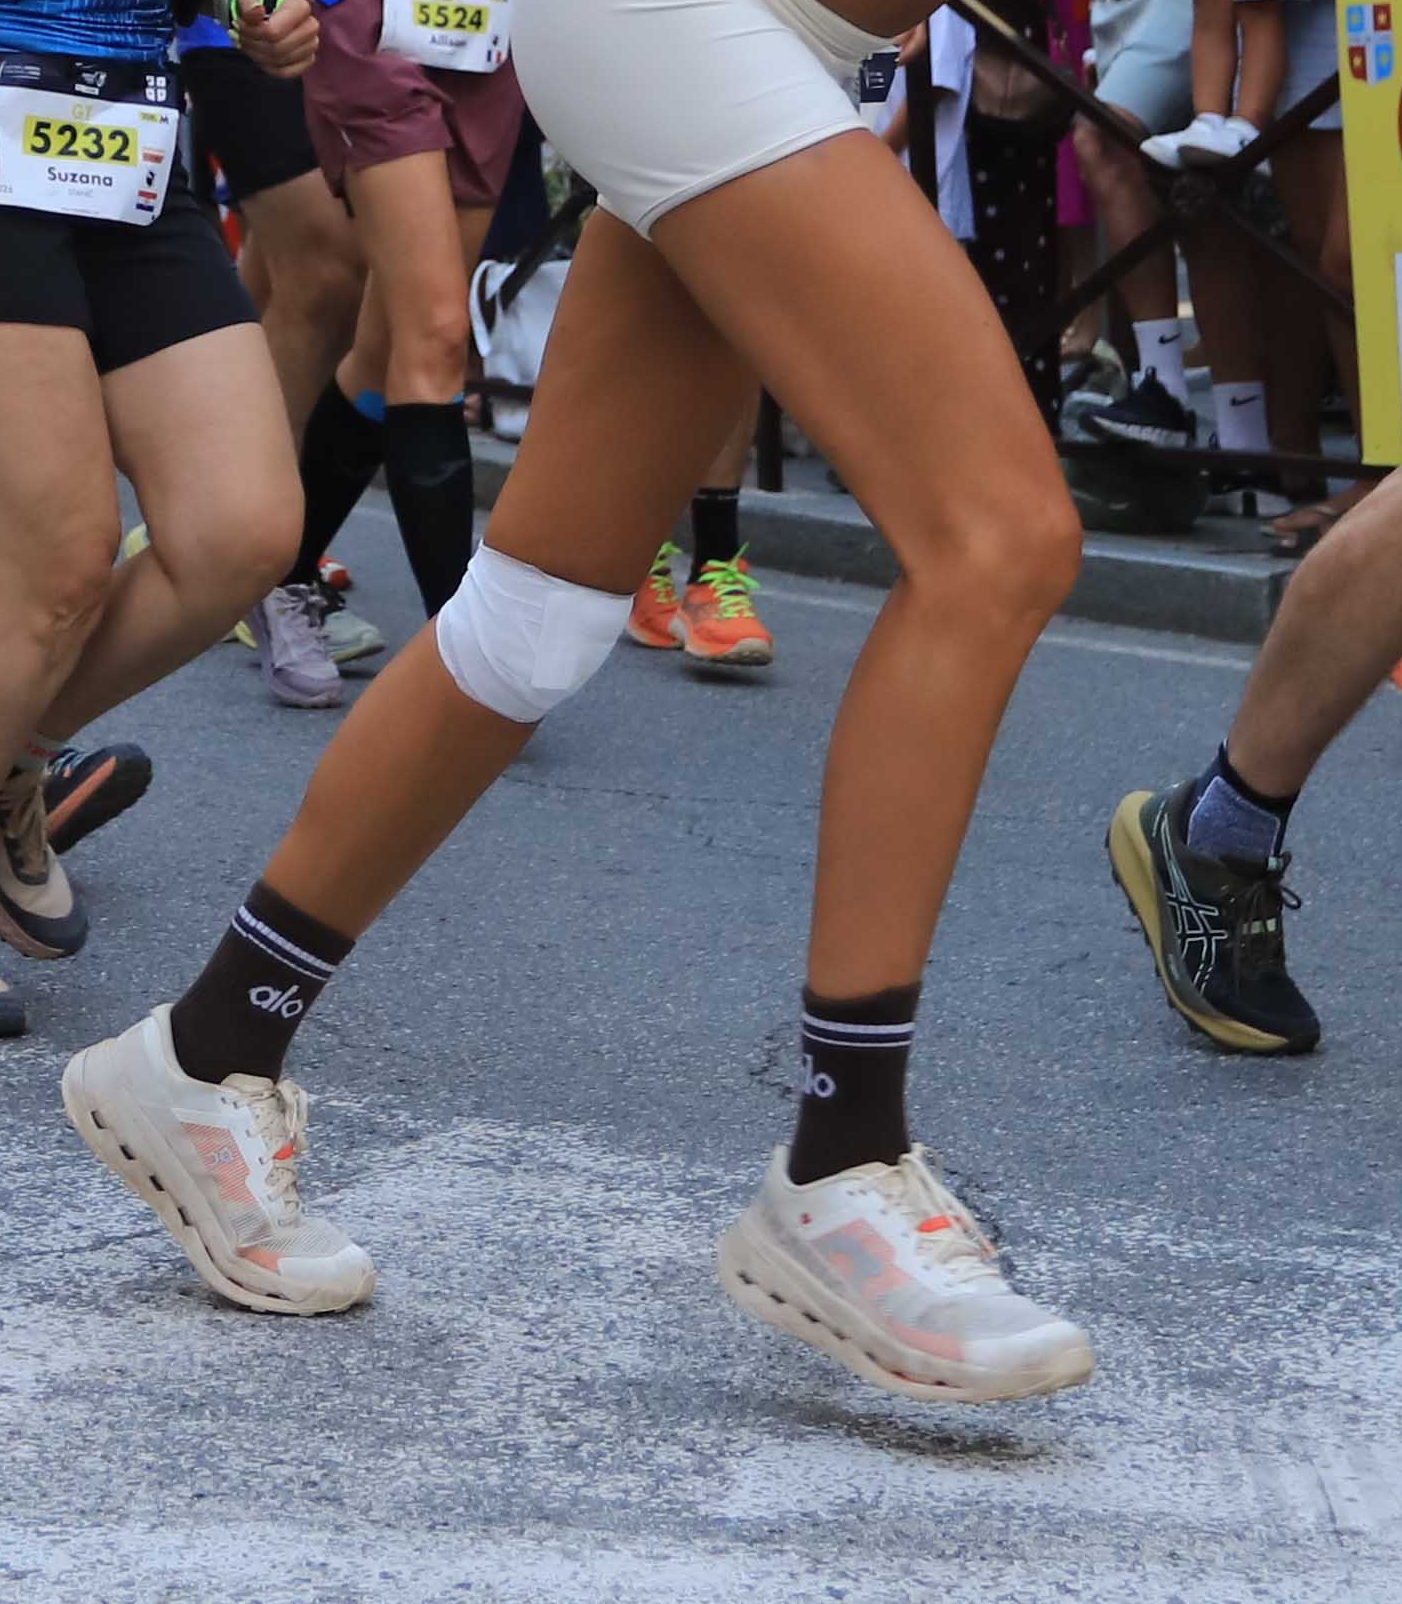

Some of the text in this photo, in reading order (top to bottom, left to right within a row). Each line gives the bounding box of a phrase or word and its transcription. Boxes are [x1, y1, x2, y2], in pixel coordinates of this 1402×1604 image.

[418, 3, 484, 31] 5524
[29, 120, 132, 163] 5232
[47, 166, 114, 188] Suzana
[248, 984, 304, 1019] alo
[803, 1052, 837, 1098] lo
